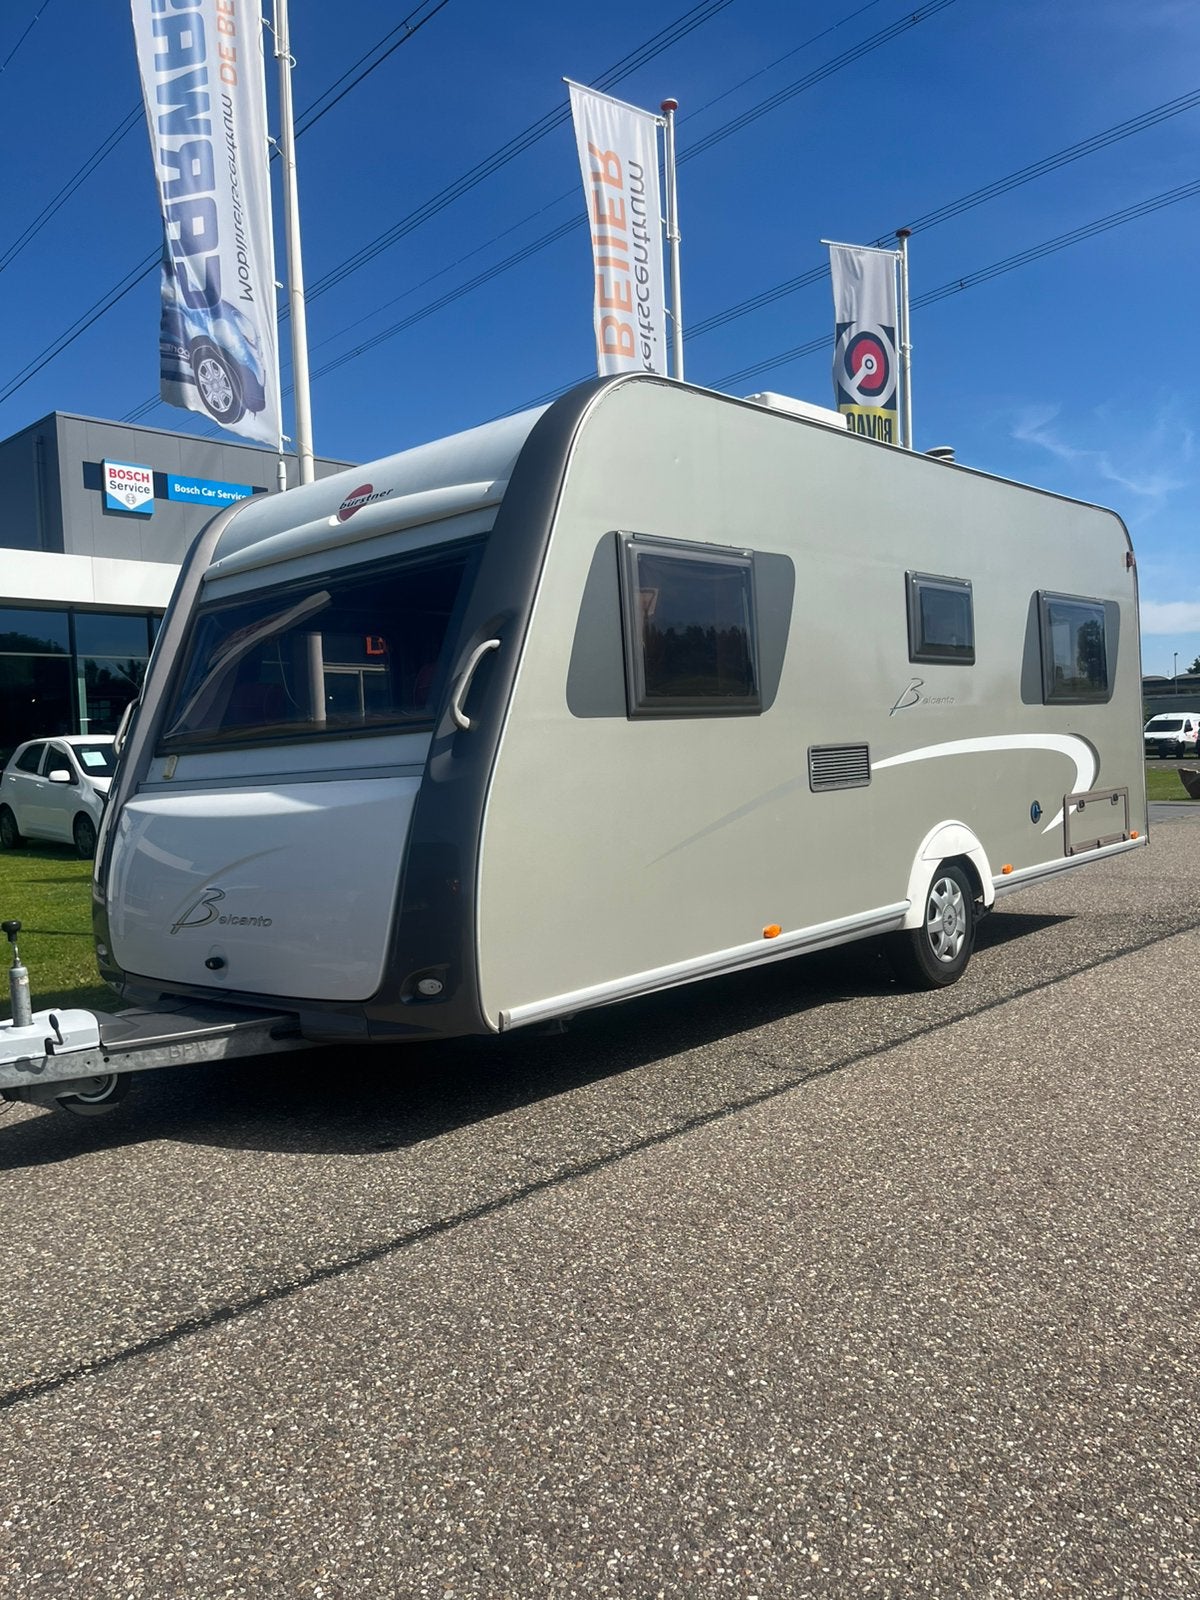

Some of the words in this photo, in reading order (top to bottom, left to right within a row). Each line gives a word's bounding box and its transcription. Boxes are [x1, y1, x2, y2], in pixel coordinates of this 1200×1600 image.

[108, 467, 150, 483] BOSCH
[109, 480, 151, 494] Service
[174, 484, 200, 495] Bosch
[201, 487, 216, 497] Car
[170, 887, 273, 935] Belcanto
